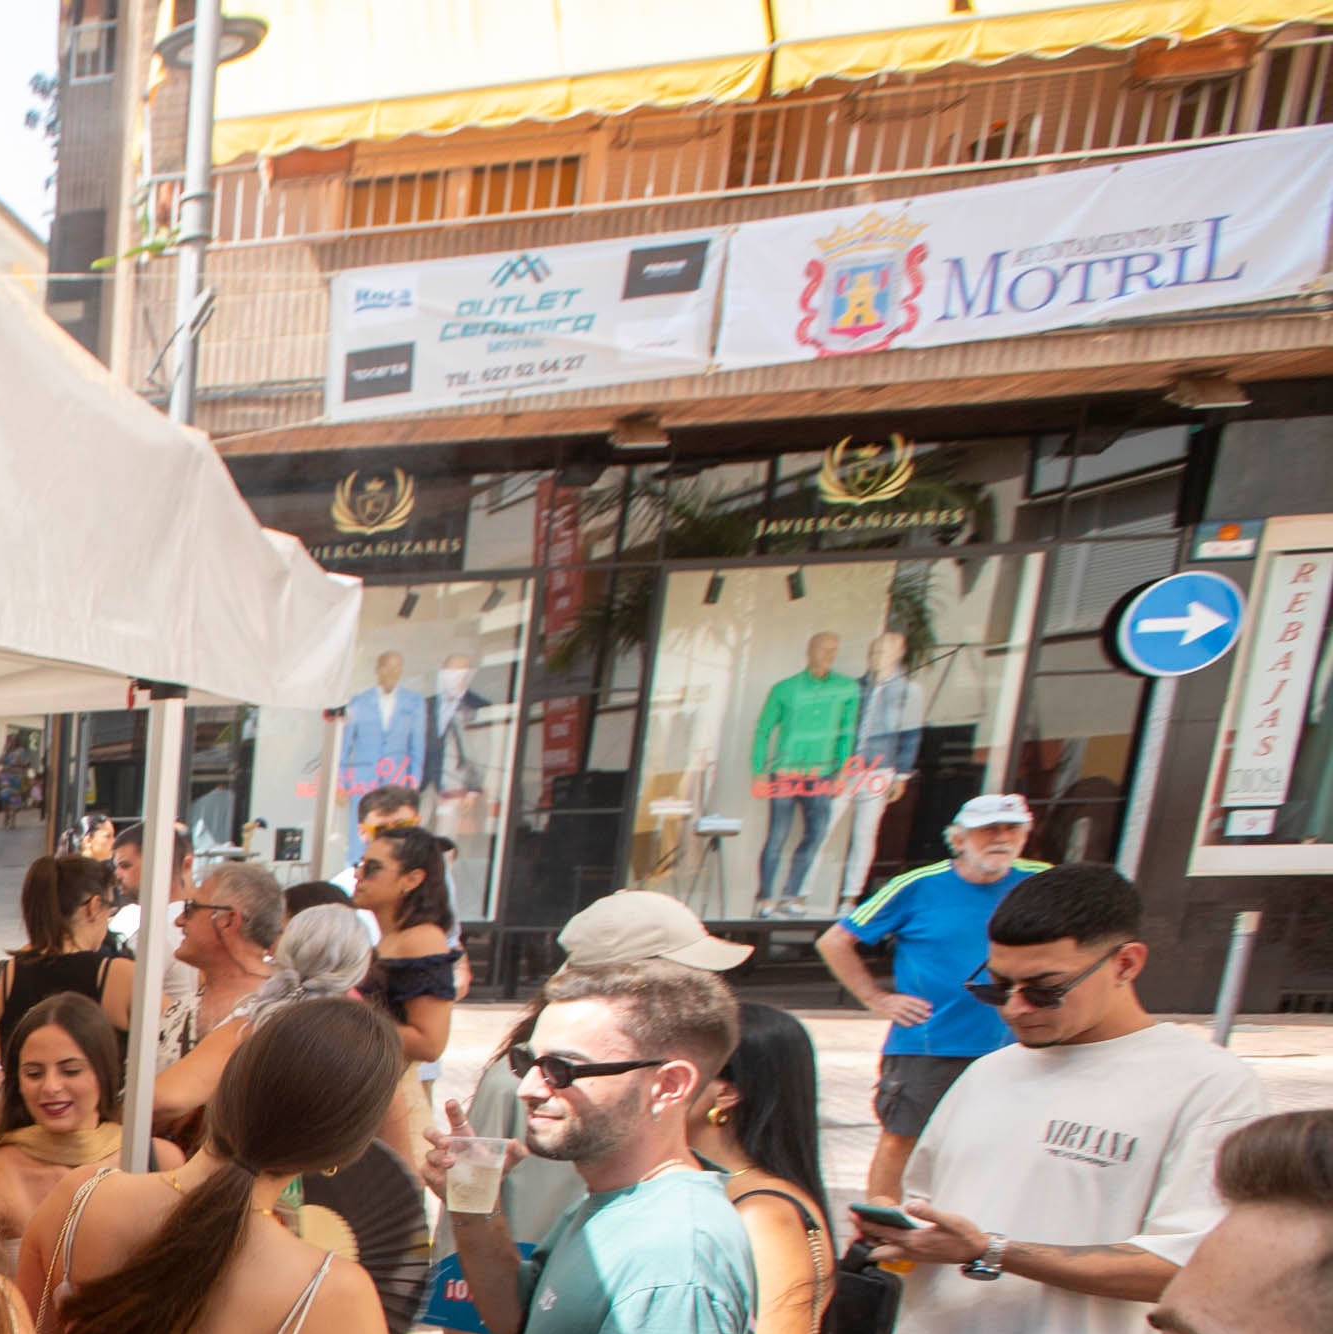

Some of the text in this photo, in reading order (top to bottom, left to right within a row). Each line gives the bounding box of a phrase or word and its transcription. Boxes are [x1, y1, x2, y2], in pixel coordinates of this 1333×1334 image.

[1013, 220, 1197, 265] AYUNTAMIENTO DE
[935, 214, 1247, 323] MOTRIL
[455, 288, 584, 318] OUTLET
[563, 354, 588, 373] 27
[1254, 561, 1318, 758] REBAJAS
